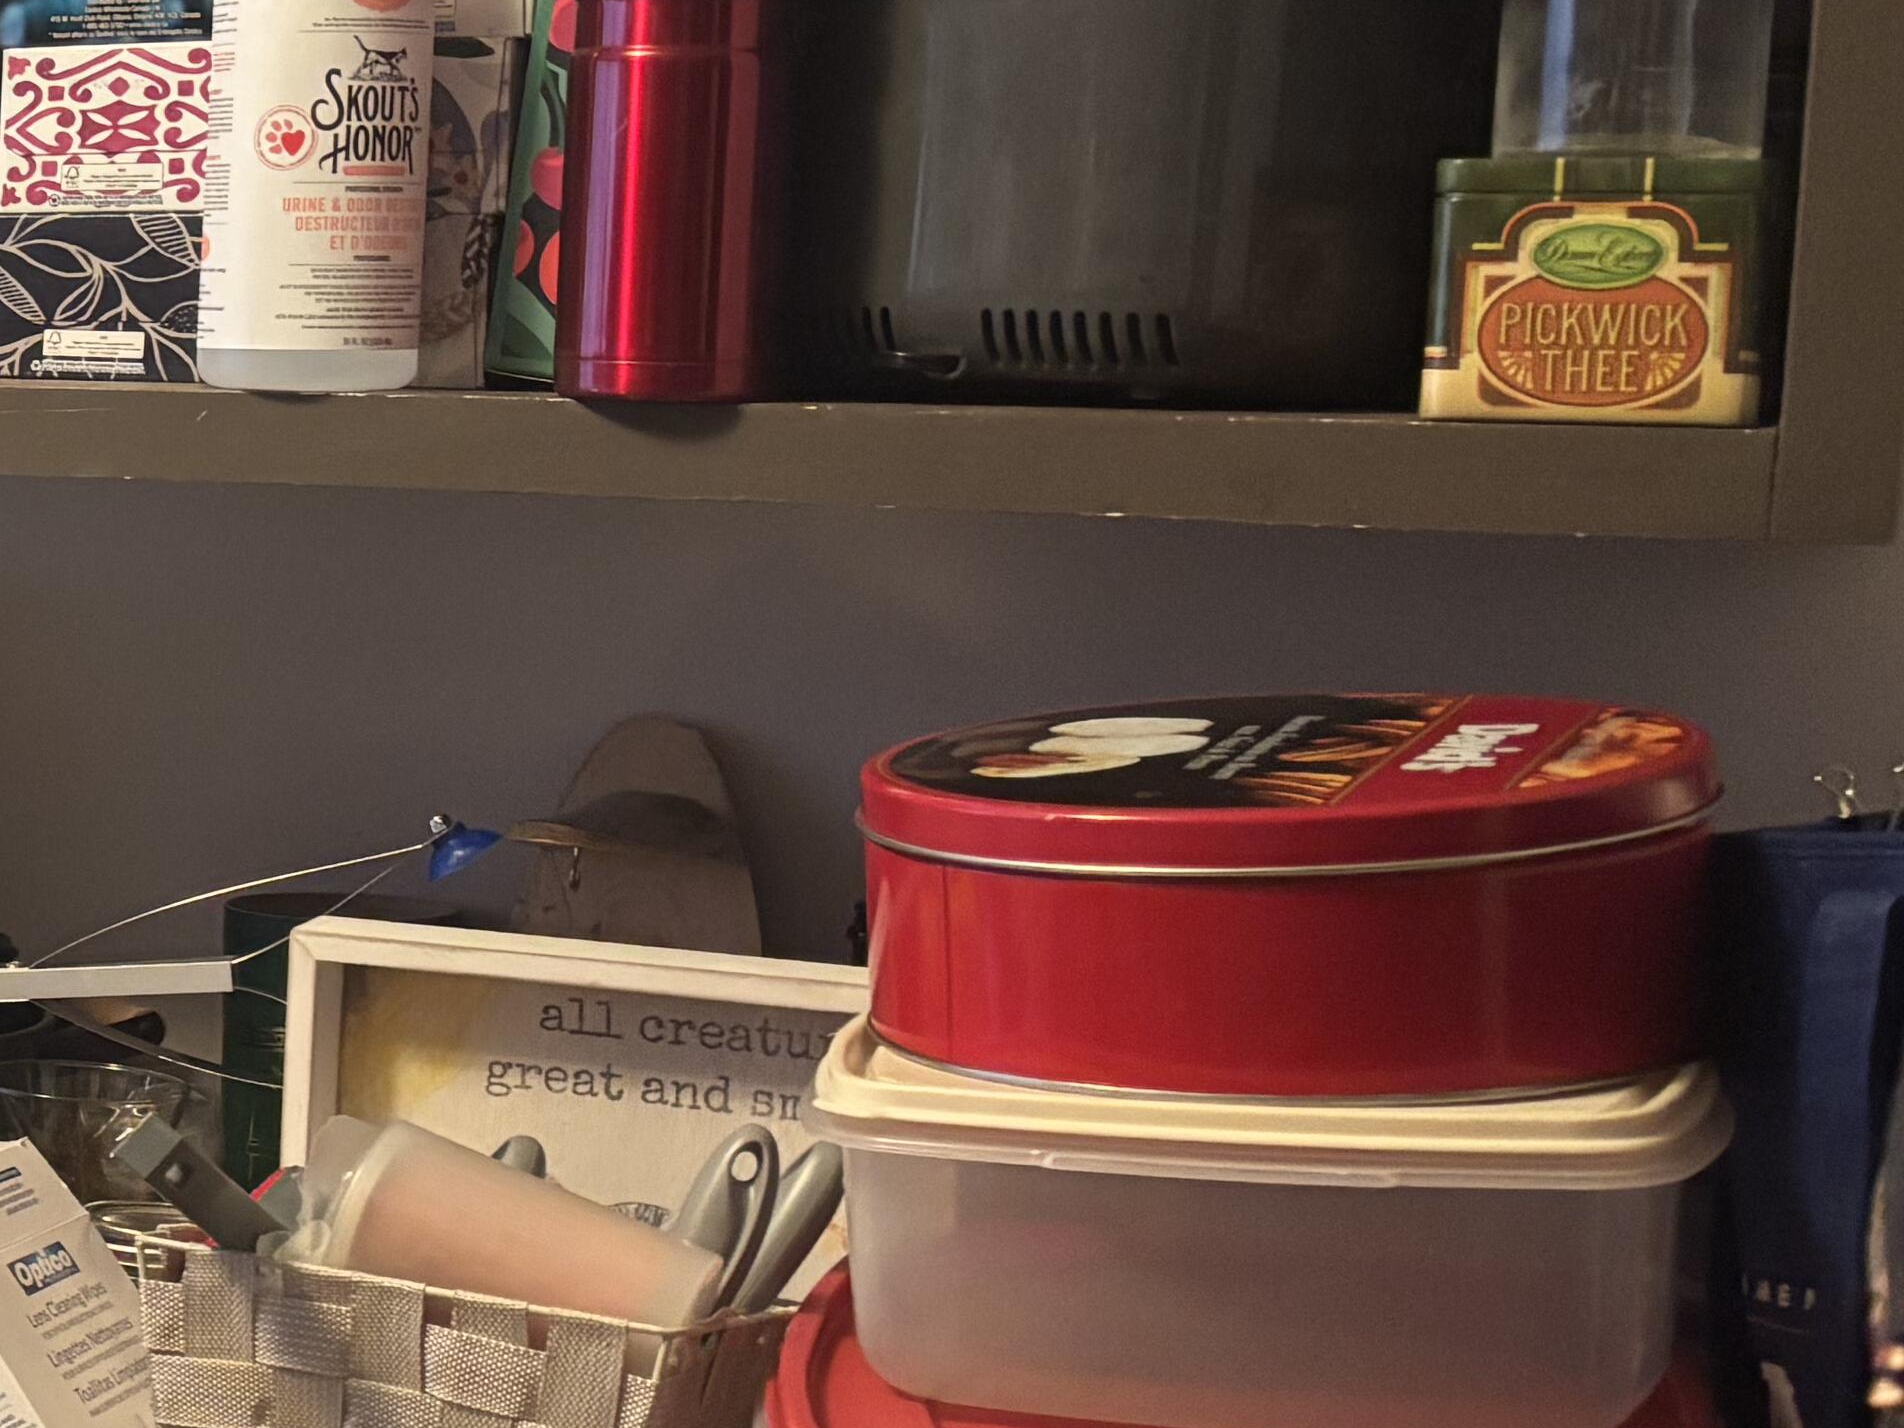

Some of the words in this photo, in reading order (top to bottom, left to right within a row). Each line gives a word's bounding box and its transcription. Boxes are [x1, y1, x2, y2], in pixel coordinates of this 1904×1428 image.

[310, 68, 420, 131] SKOUT'S
[318, 125, 414, 175] HONOR
[282, 197, 326, 213] URINE
[331, 198, 341, 212] &
[347, 197, 382, 213] ODOR
[295, 216, 390, 232] DESTRUCTEUR
[330, 235, 346, 251] ET
[1499, 301, 1689, 347] PICKWICK
[1540, 349, 1641, 393] THEE
[539, 998, 624, 1040] all
[639, 1015, 835, 1061] creatur
[485, 1060, 624, 1098] great
[641, 1076, 733, 1114] and
[14, 1249, 73, 1289] Optico
